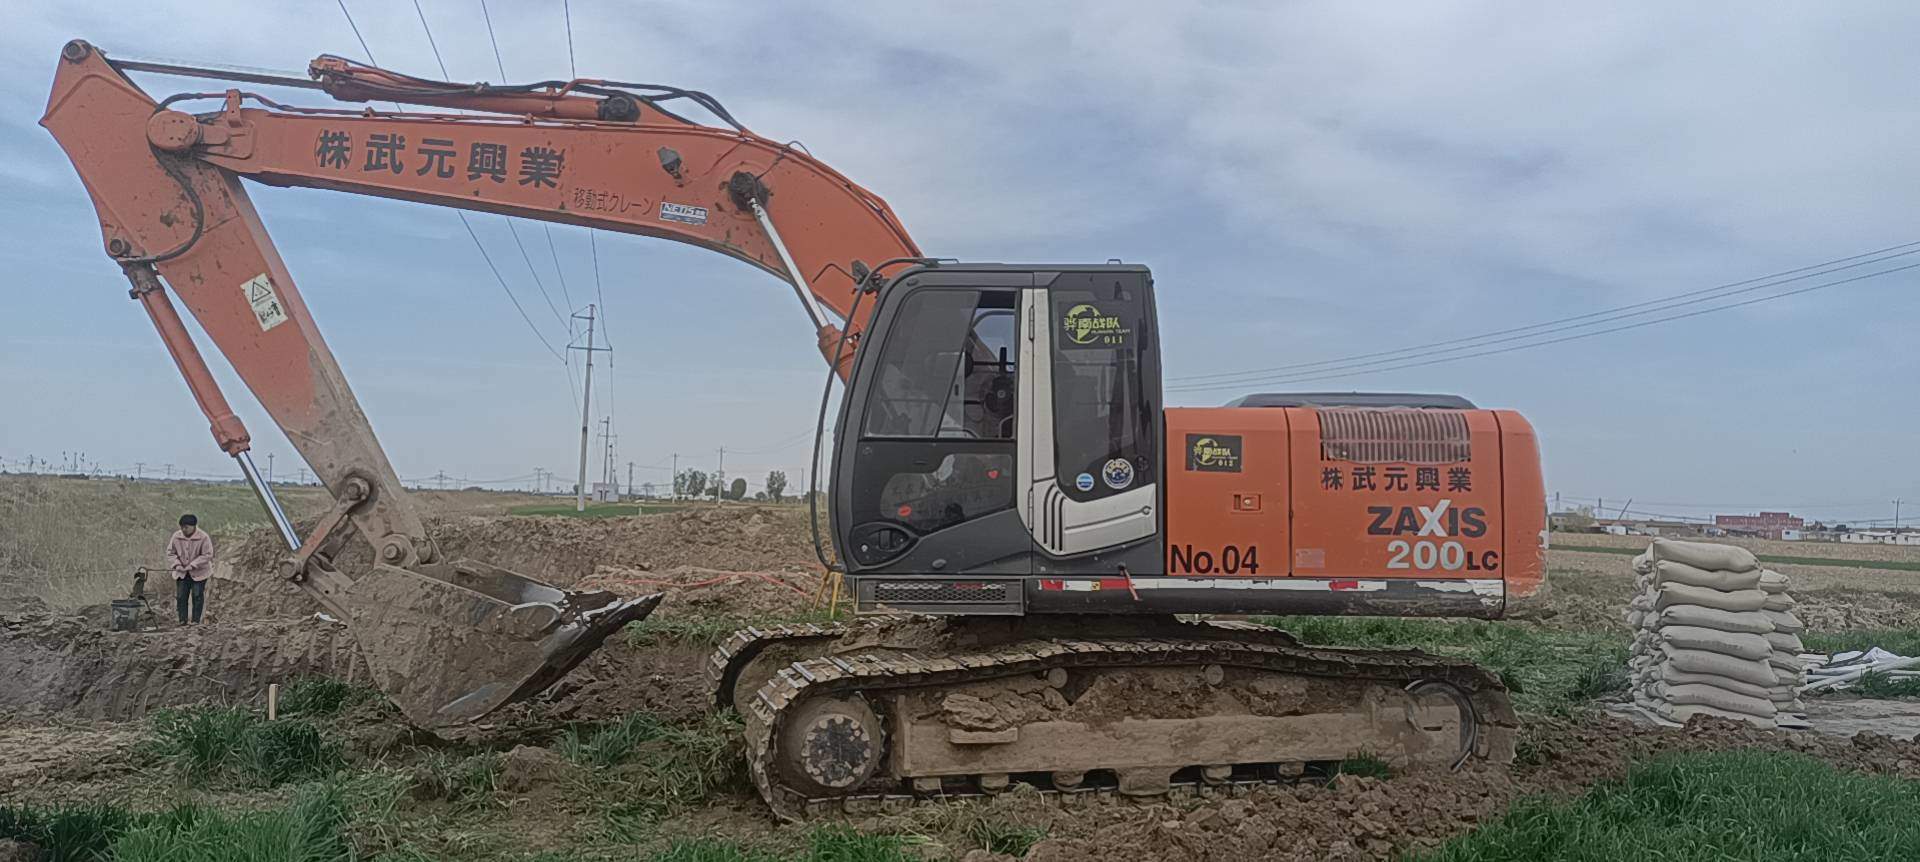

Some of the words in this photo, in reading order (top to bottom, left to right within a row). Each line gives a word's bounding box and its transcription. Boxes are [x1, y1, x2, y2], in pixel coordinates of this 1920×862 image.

[574, 187, 654, 215] 移動式クレーン
[1104, 335, 1123, 344] 011
[1218, 459, 1233, 467] 012
[1367, 499, 1487, 538] ZAXIS
[1171, 544, 1259, 575] No.04
